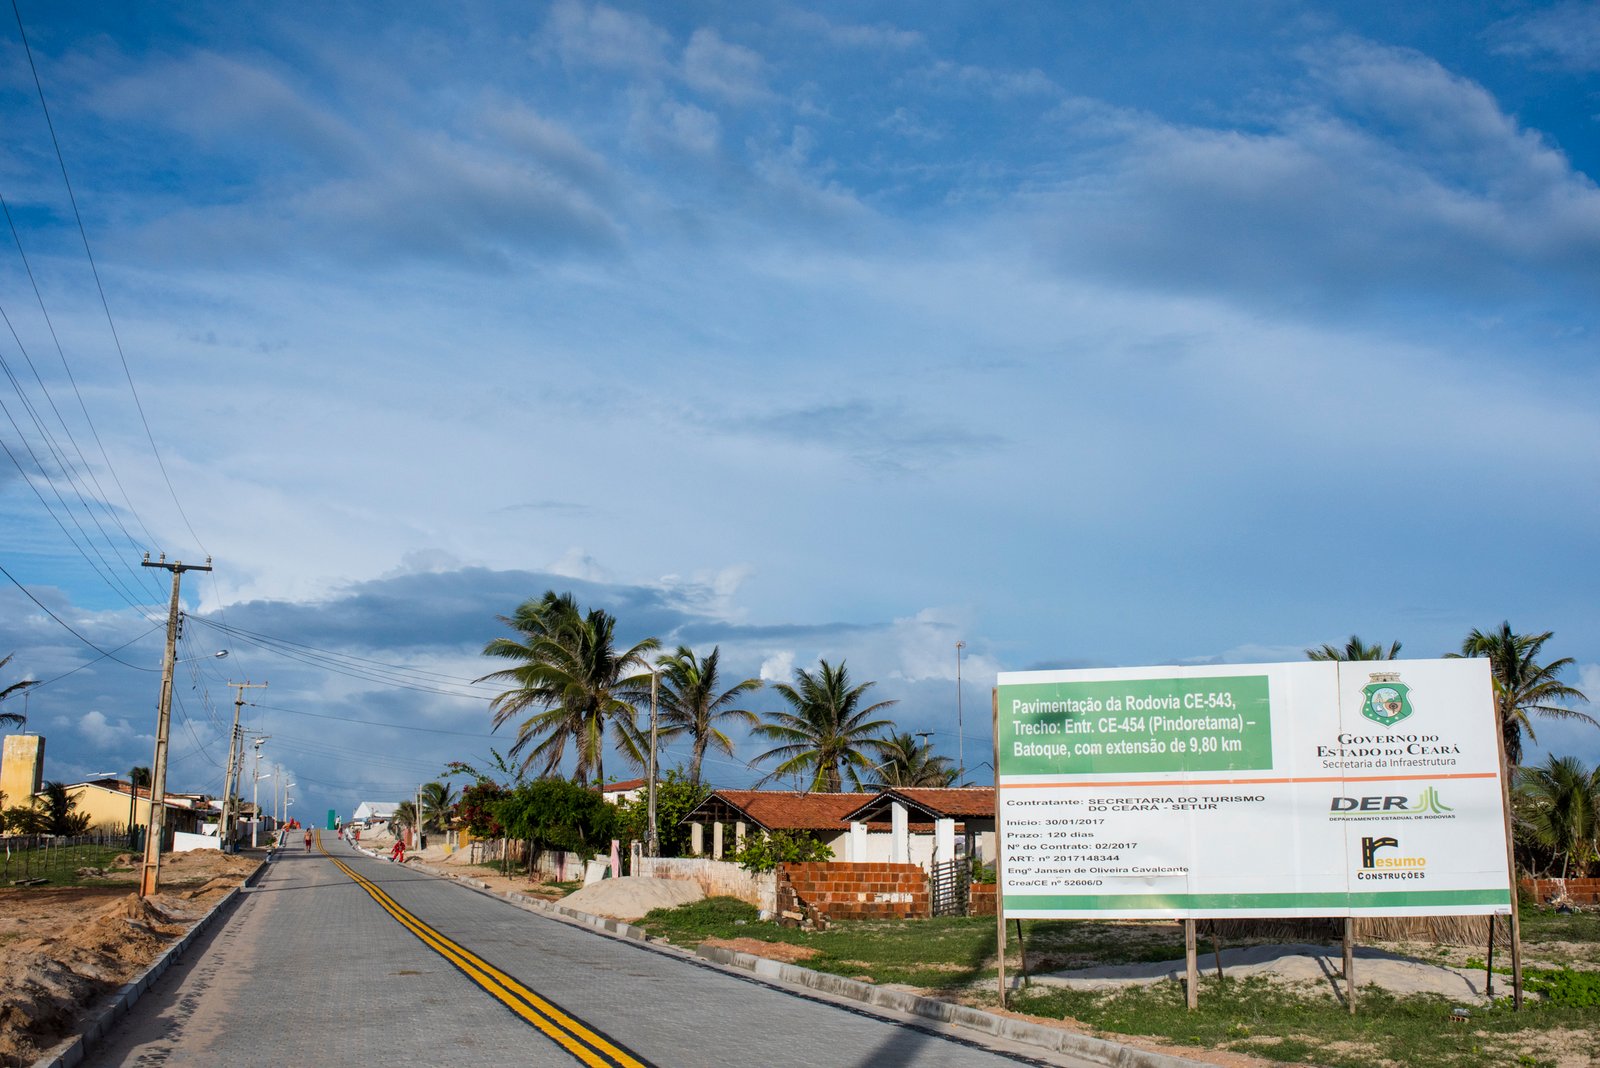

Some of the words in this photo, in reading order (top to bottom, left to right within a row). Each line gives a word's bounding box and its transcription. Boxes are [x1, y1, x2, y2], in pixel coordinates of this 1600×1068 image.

[1012, 697, 1102, 716] Pavimentação
[1106, 696, 1122, 711] da
[1126, 694, 1180, 710] Rodovia
[1184, 693, 1236, 710] CE-543,
[1013, 719, 1061, 735] Trecho:
[1065, 718, 1095, 734] Entr.
[1098, 717, 1145, 733] CE-454
[1149, 714, 1243, 735] (Pindoretama)
[1337, 733, 1418, 744] GOVERNO
[1014, 741, 1070, 759] Batoque,
[1074, 742, 1102, 755] com
[1106, 738, 1166, 754] extensão
[1170, 738, 1186, 753] de
[1189, 737, 1218, 755] 9,80
[1221, 737, 1242, 752] km
[1317, 745, 1381, 757] ESTADO
[1385, 748, 1403, 756] DO
[1407, 743, 1460, 755] CEARÁ
[1322, 758, 1372, 769] Secretaria
[1375, 758, 1387, 768] da
[1390, 757, 1456, 767] Infraestrutura
[1202, 795, 1265, 803] TURISMO
[1330, 796, 1408, 811] DER
[1112, 803, 1160, 811] CEARÁ
[1045, 818, 1105, 826] 30/01/2017
[1095, 842, 1137, 850] 02/2017
[1357, 870, 1425, 880] CONSTRUÇÕES
